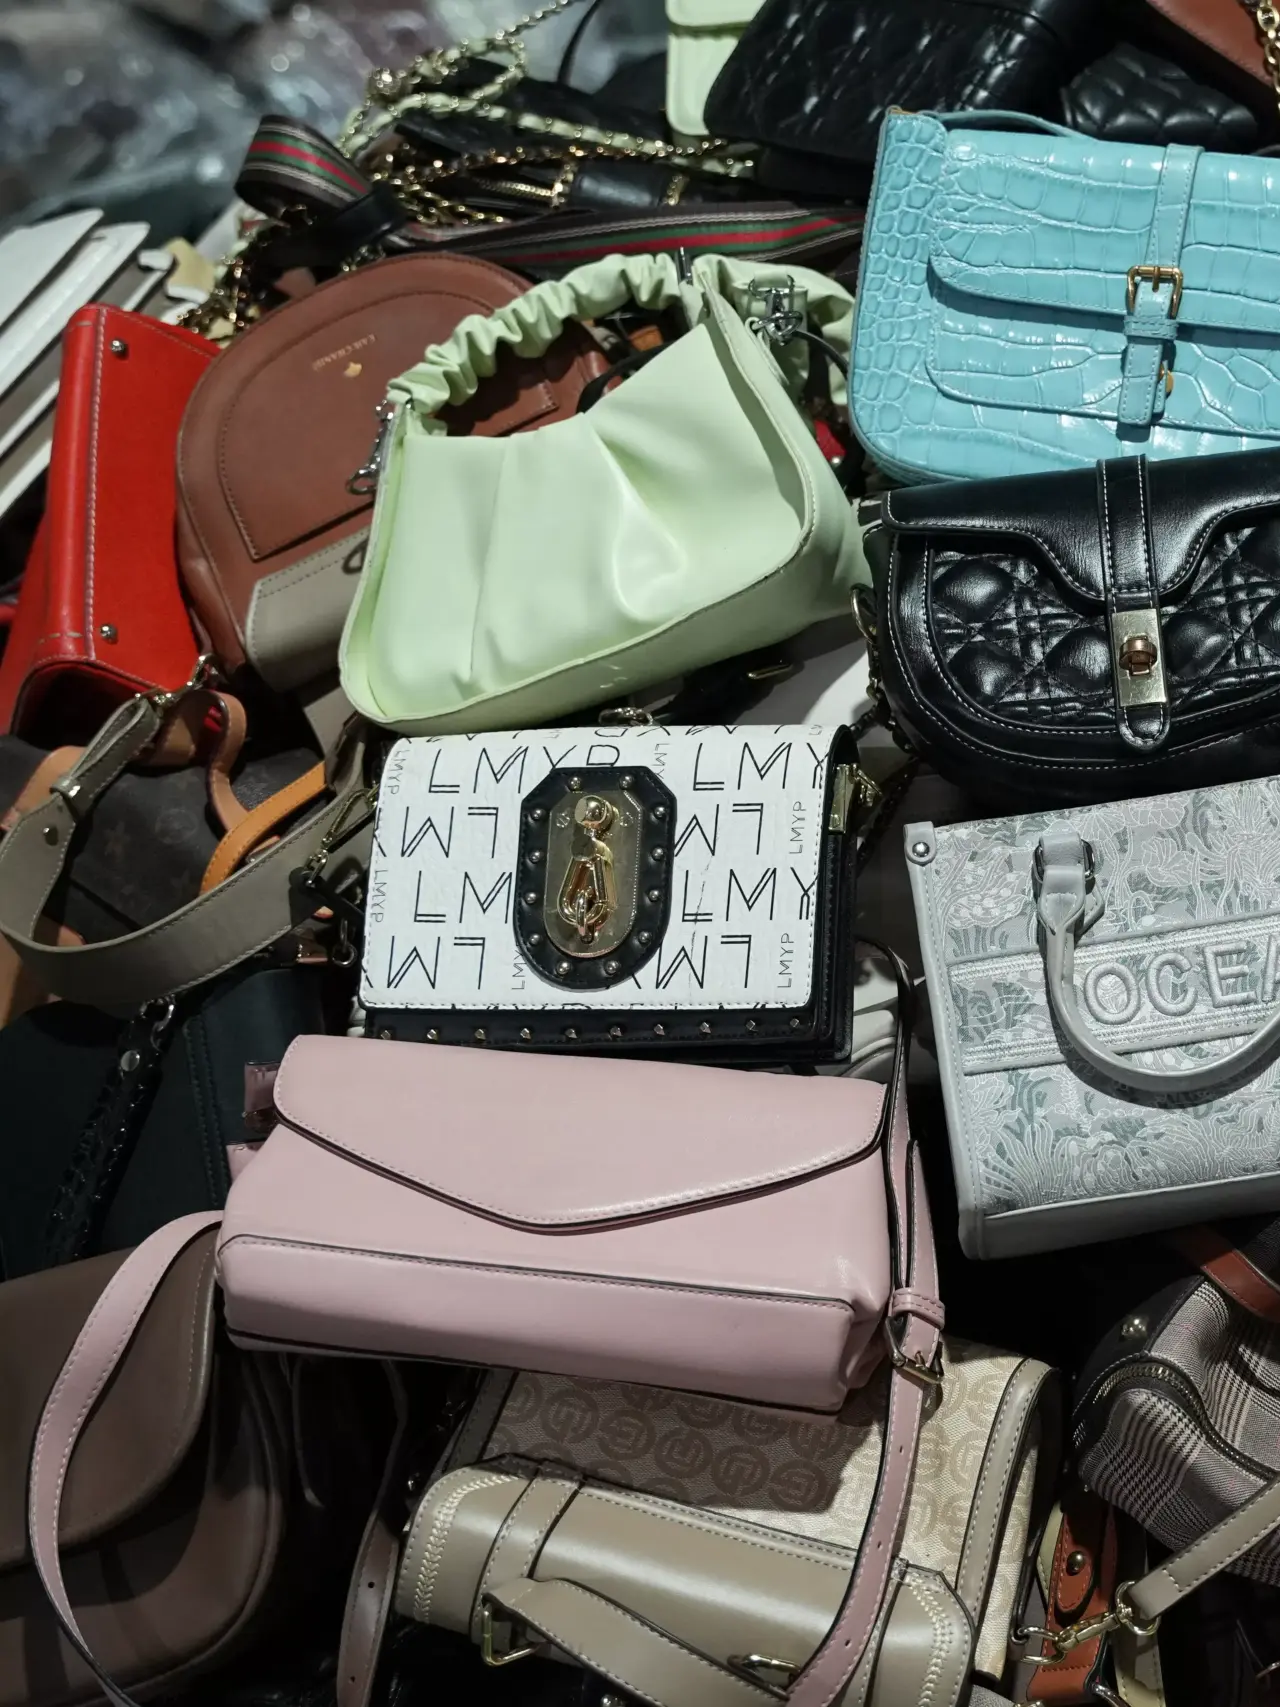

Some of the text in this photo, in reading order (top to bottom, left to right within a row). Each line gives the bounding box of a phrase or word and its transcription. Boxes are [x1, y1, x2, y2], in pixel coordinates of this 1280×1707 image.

[386, 750, 410, 795] LMYP
[650, 743, 670, 780] LMY
[693, 742, 829, 791] LMY
[789, 801, 807, 854] LMYP
[370, 869, 388, 923] LMYP
[413, 870, 513, 924] LM
[682, 866, 819, 922] LMY
[777, 932, 794, 988] LMYP
